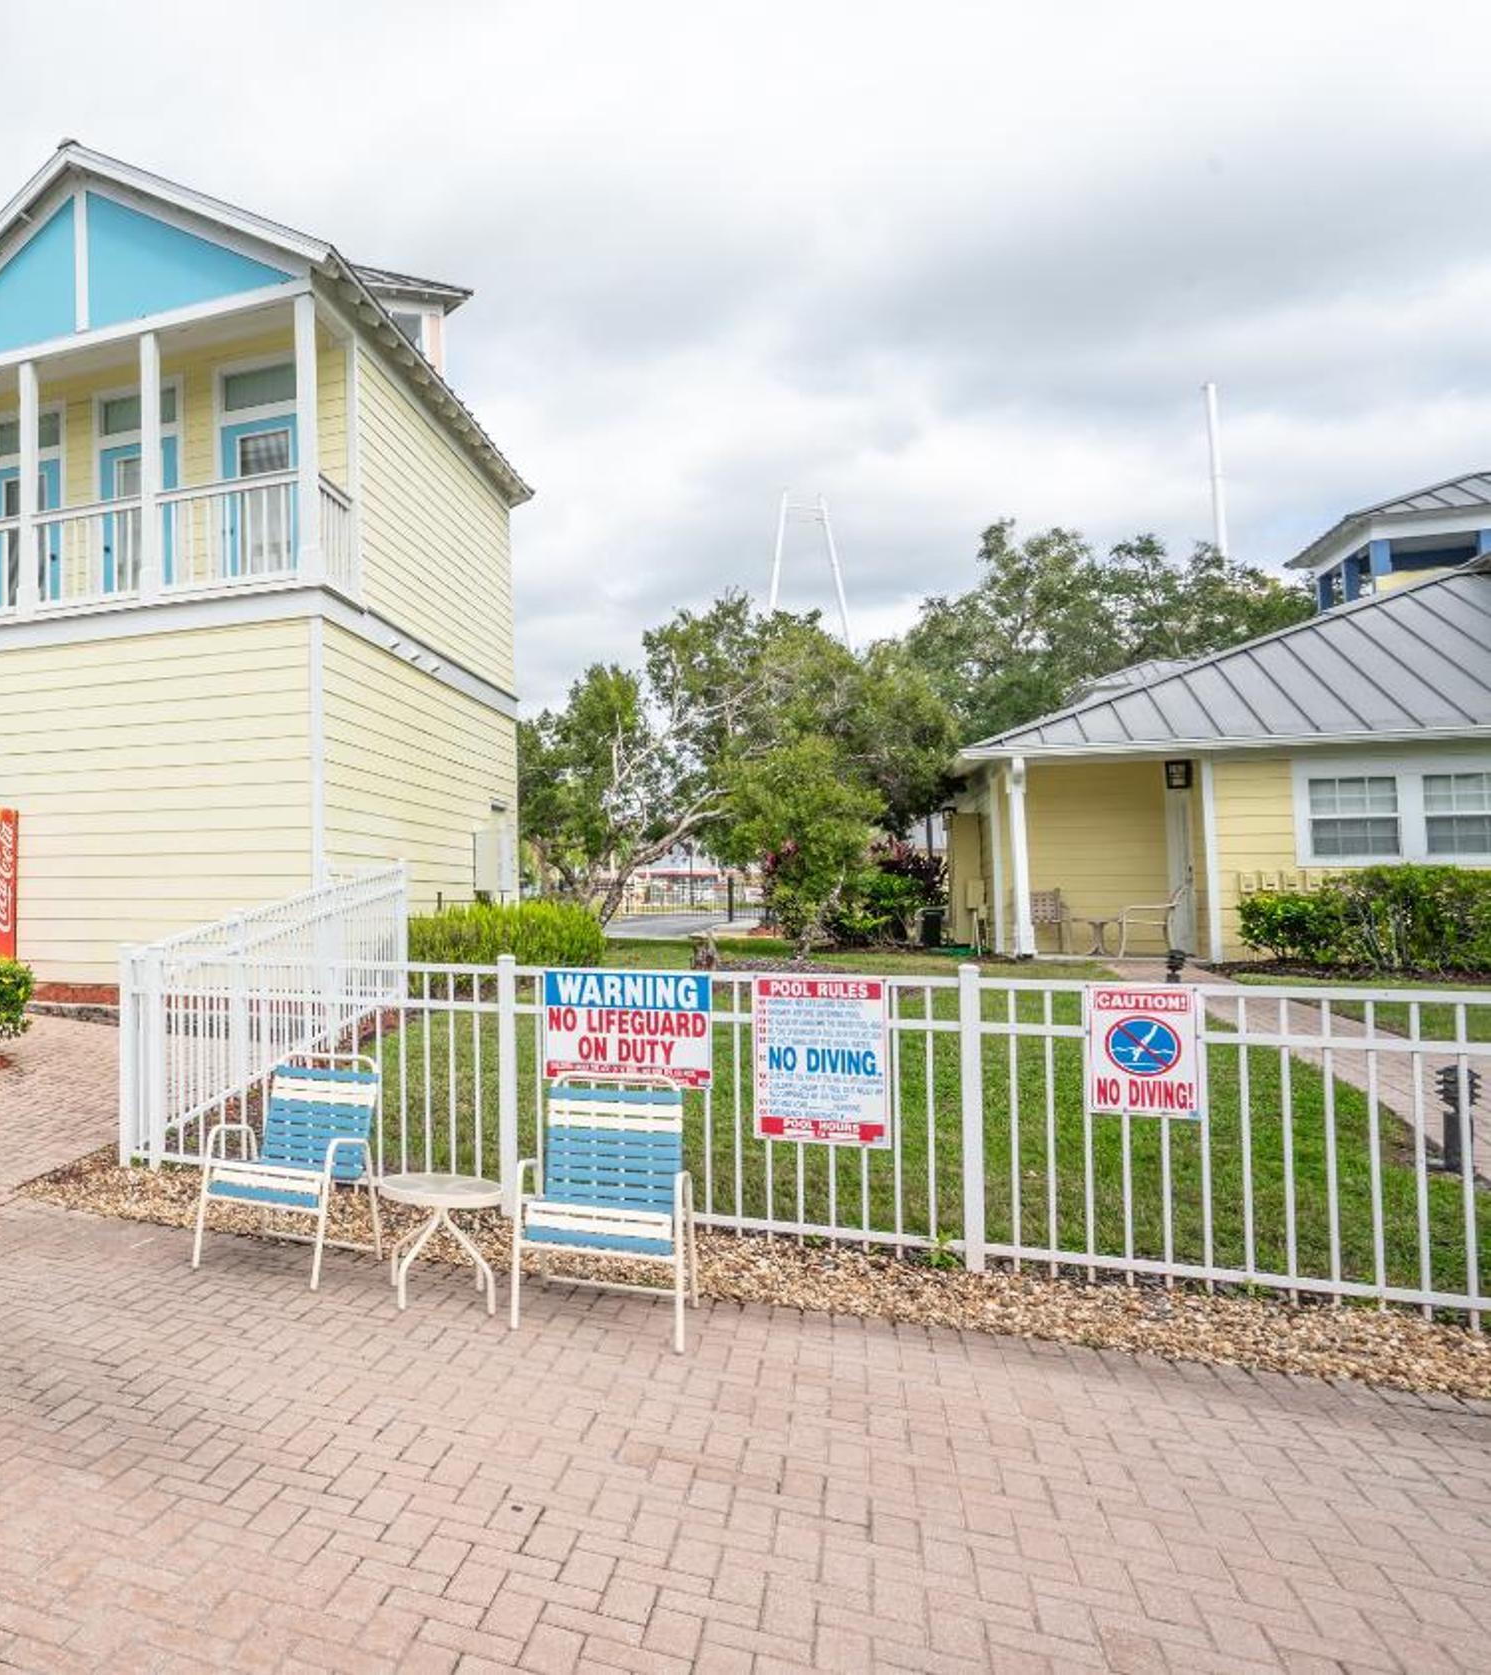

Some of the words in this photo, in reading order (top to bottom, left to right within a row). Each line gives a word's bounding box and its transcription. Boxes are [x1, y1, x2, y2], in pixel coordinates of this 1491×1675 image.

[556, 974, 698, 1009] WARNING
[770, 981, 812, 996] POOL
[817, 983, 869, 998] RULES
[1098, 993, 1186, 1010] CAUTION!
[548, 1007, 577, 1031] NO
[587, 1009, 706, 1038] LIFEGUARD
[578, 1035, 607, 1061] ON
[618, 1039, 675, 1065] DUTY
[769, 1046, 797, 1071] NO
[806, 1048, 883, 1077] DIVING.
[1097, 1078, 1120, 1105] NO
[1128, 1079, 1193, 1109] DIVING!
[784, 1119, 814, 1130] POOL
[819, 1121, 860, 1134] HOURS
